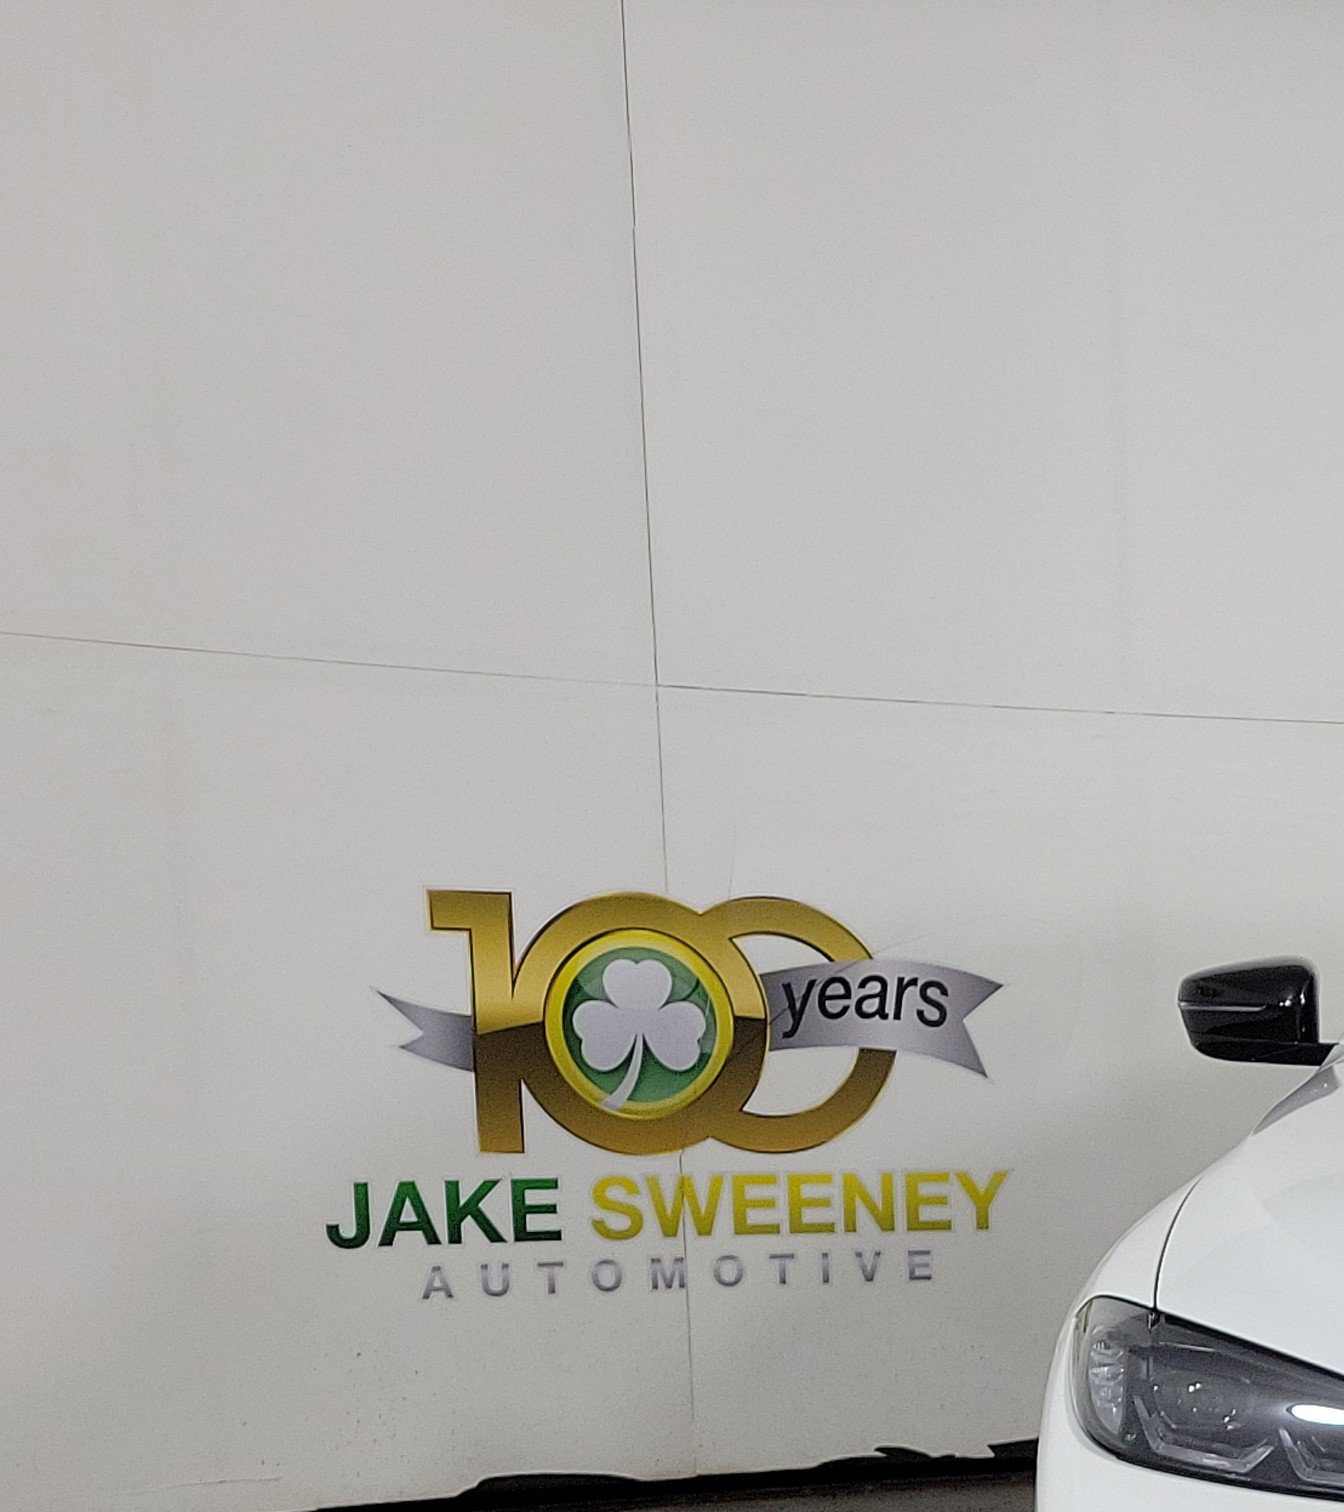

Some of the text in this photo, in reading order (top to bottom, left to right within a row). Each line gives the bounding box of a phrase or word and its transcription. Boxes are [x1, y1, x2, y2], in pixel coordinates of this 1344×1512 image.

[425, 888, 950, 1156] 100 years
[325, 1170, 1010, 1251] JAKE SWEENEY
[421, 1250, 934, 1301] AUTOMOTIVE
